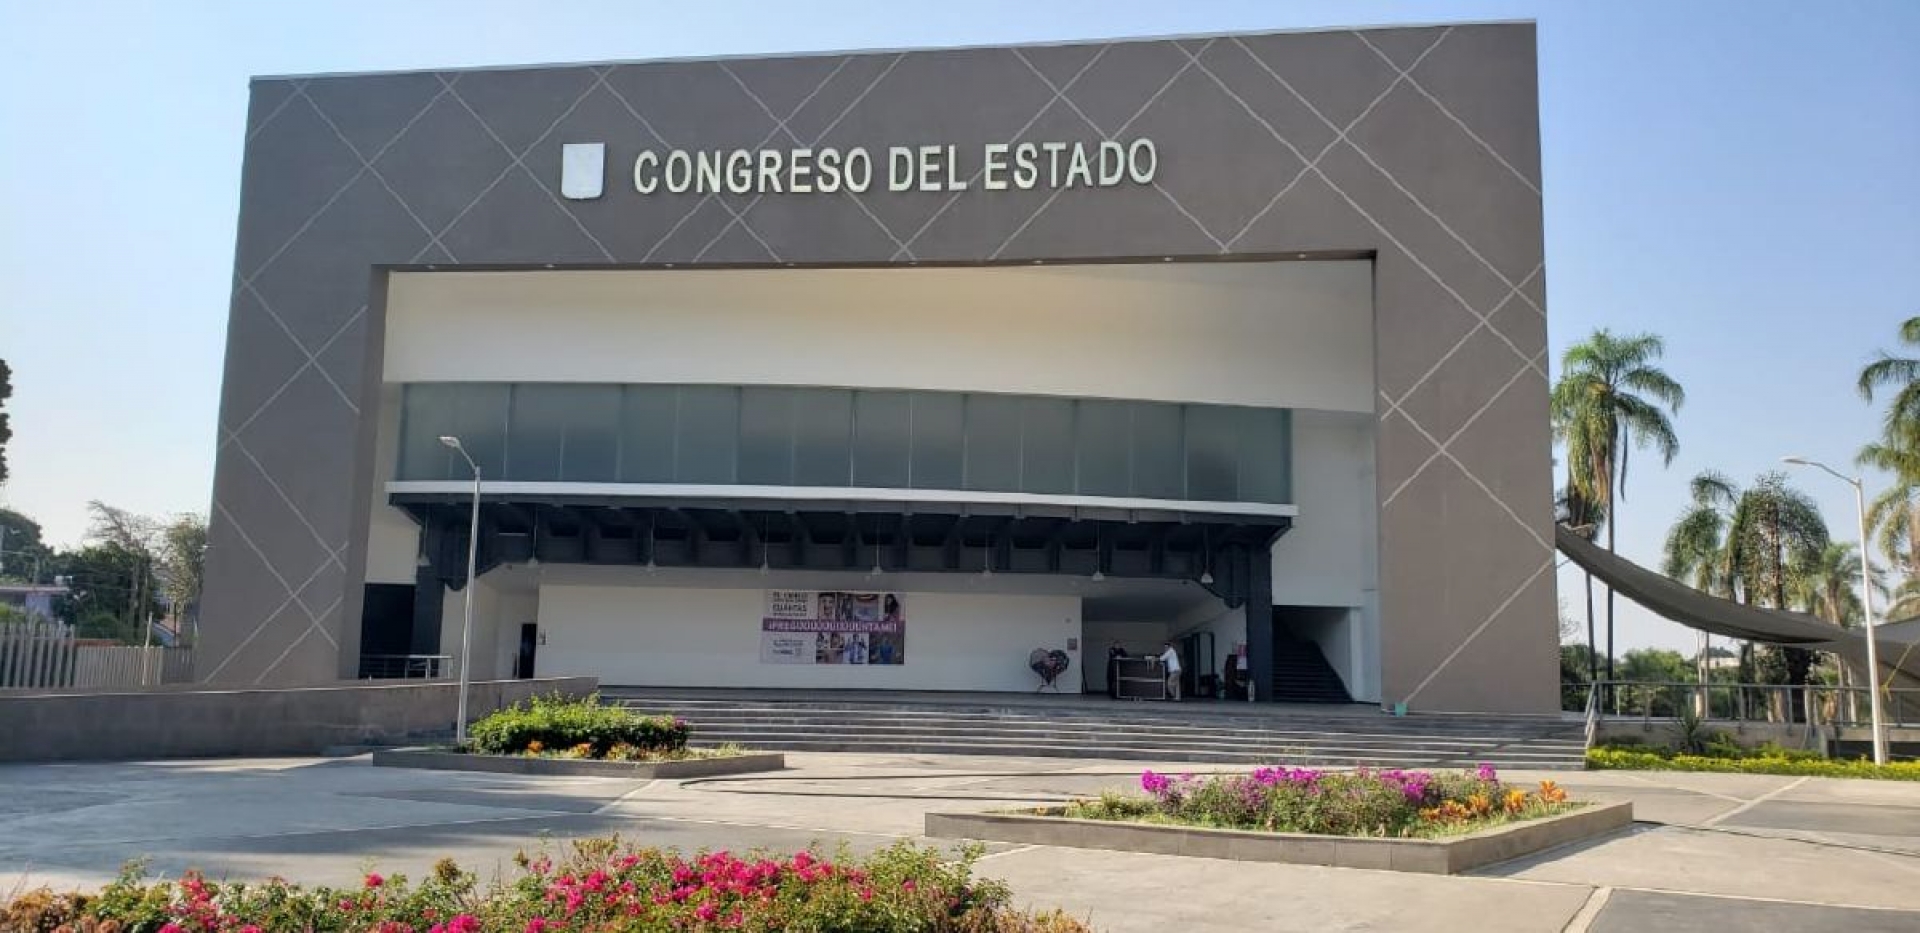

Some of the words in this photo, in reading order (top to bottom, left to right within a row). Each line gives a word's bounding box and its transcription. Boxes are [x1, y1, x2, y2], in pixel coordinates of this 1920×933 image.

[634, 147, 873, 194] CONGRESO
[889, 145, 967, 191] DEL
[985, 138, 1157, 190] ESTADO
